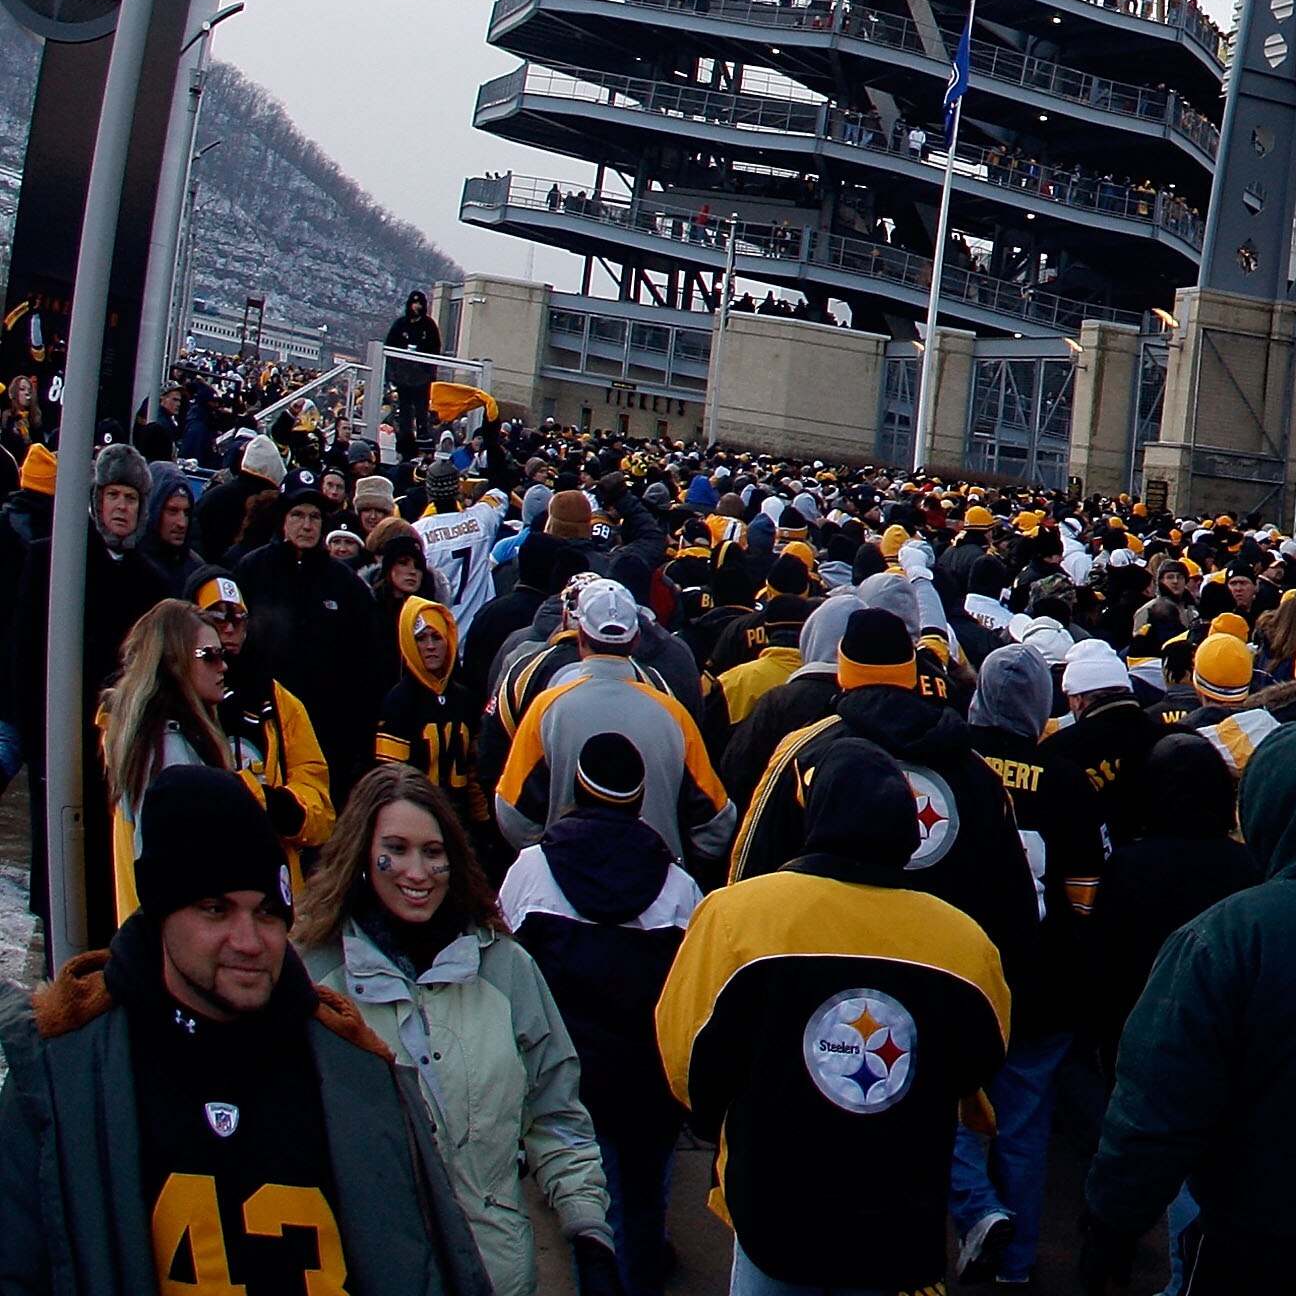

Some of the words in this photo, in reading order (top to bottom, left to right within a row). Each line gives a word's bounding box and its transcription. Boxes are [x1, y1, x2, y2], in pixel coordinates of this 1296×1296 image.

[592, 523, 612, 540] 58
[451, 545, 473, 606] 7
[819, 1039, 860, 1055] Steelers
[150, 1171, 350, 1296] 43
